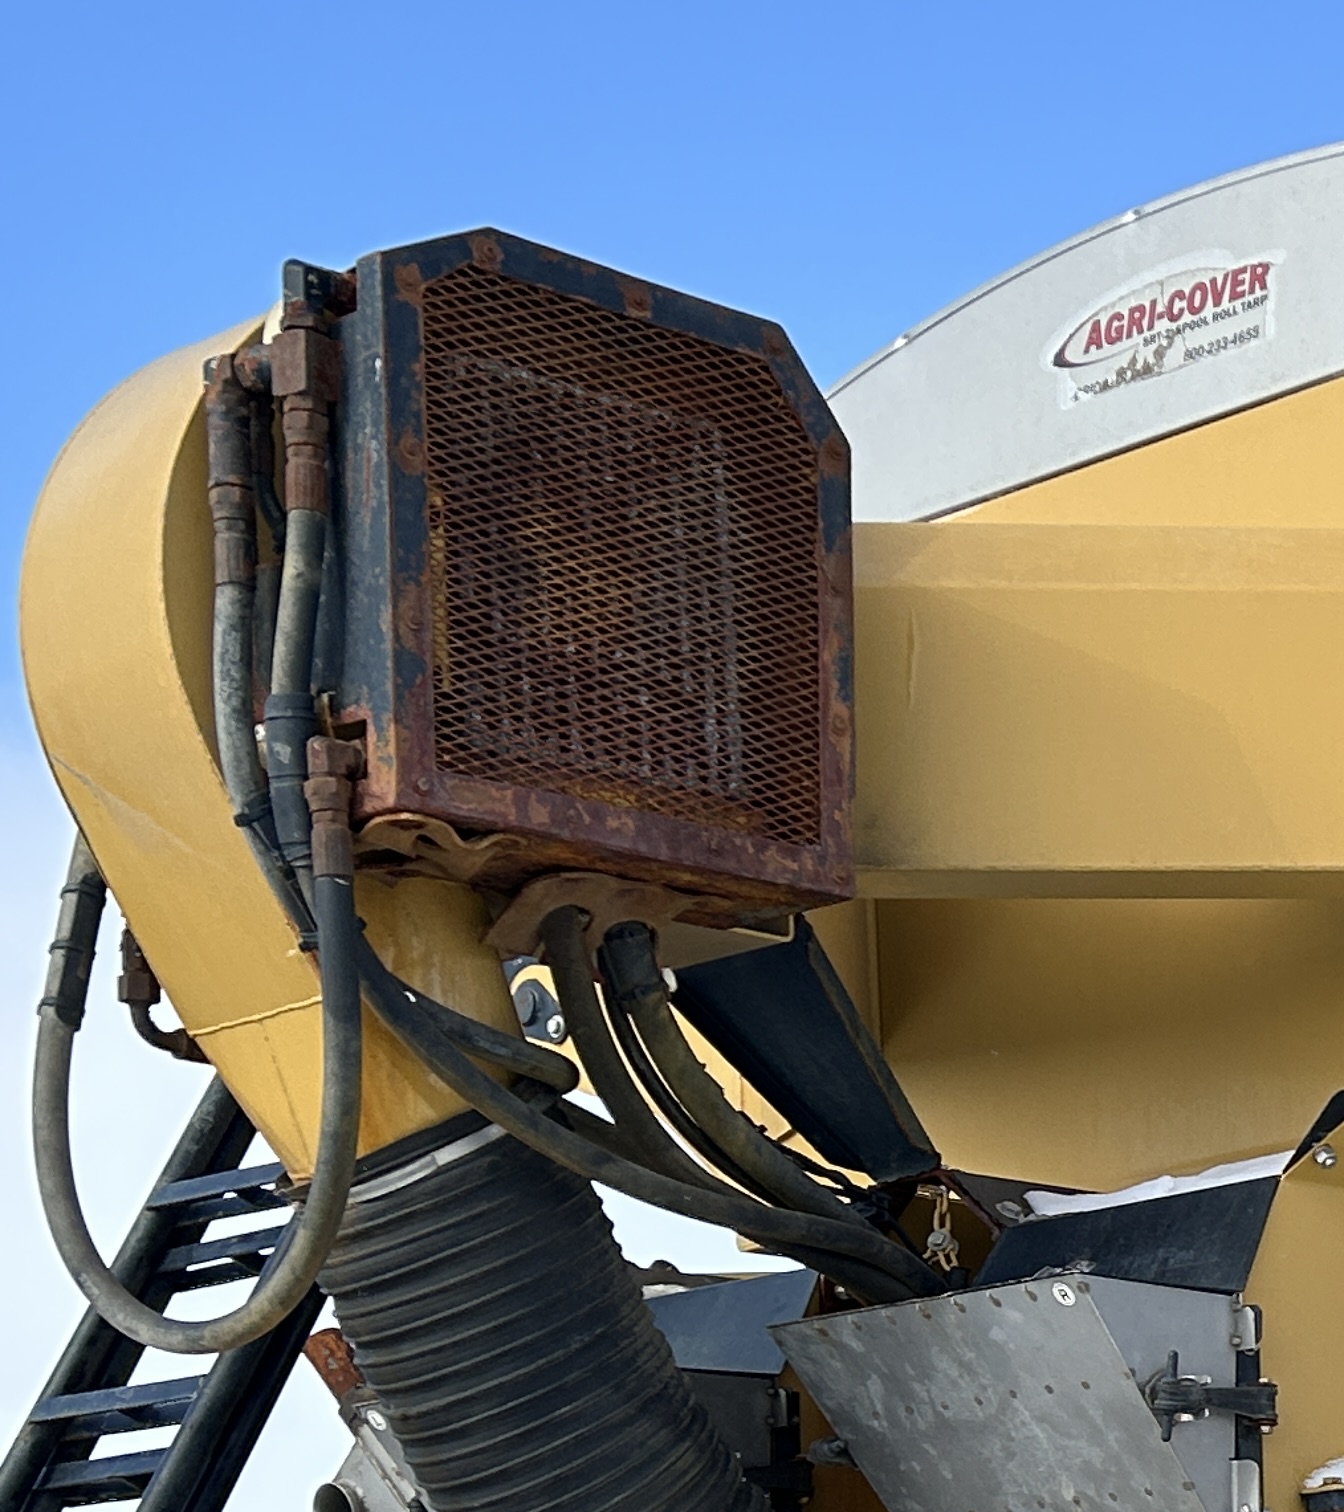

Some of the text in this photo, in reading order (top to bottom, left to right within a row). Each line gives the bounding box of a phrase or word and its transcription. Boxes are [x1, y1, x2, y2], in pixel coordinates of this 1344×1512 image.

[1083, 262, 1270, 355] AGRI-COVER
[1212, 305, 1238, 323] ROLL
[1241, 294, 1268, 313] TARP
[1057, 1288, 1072, 1302] R
